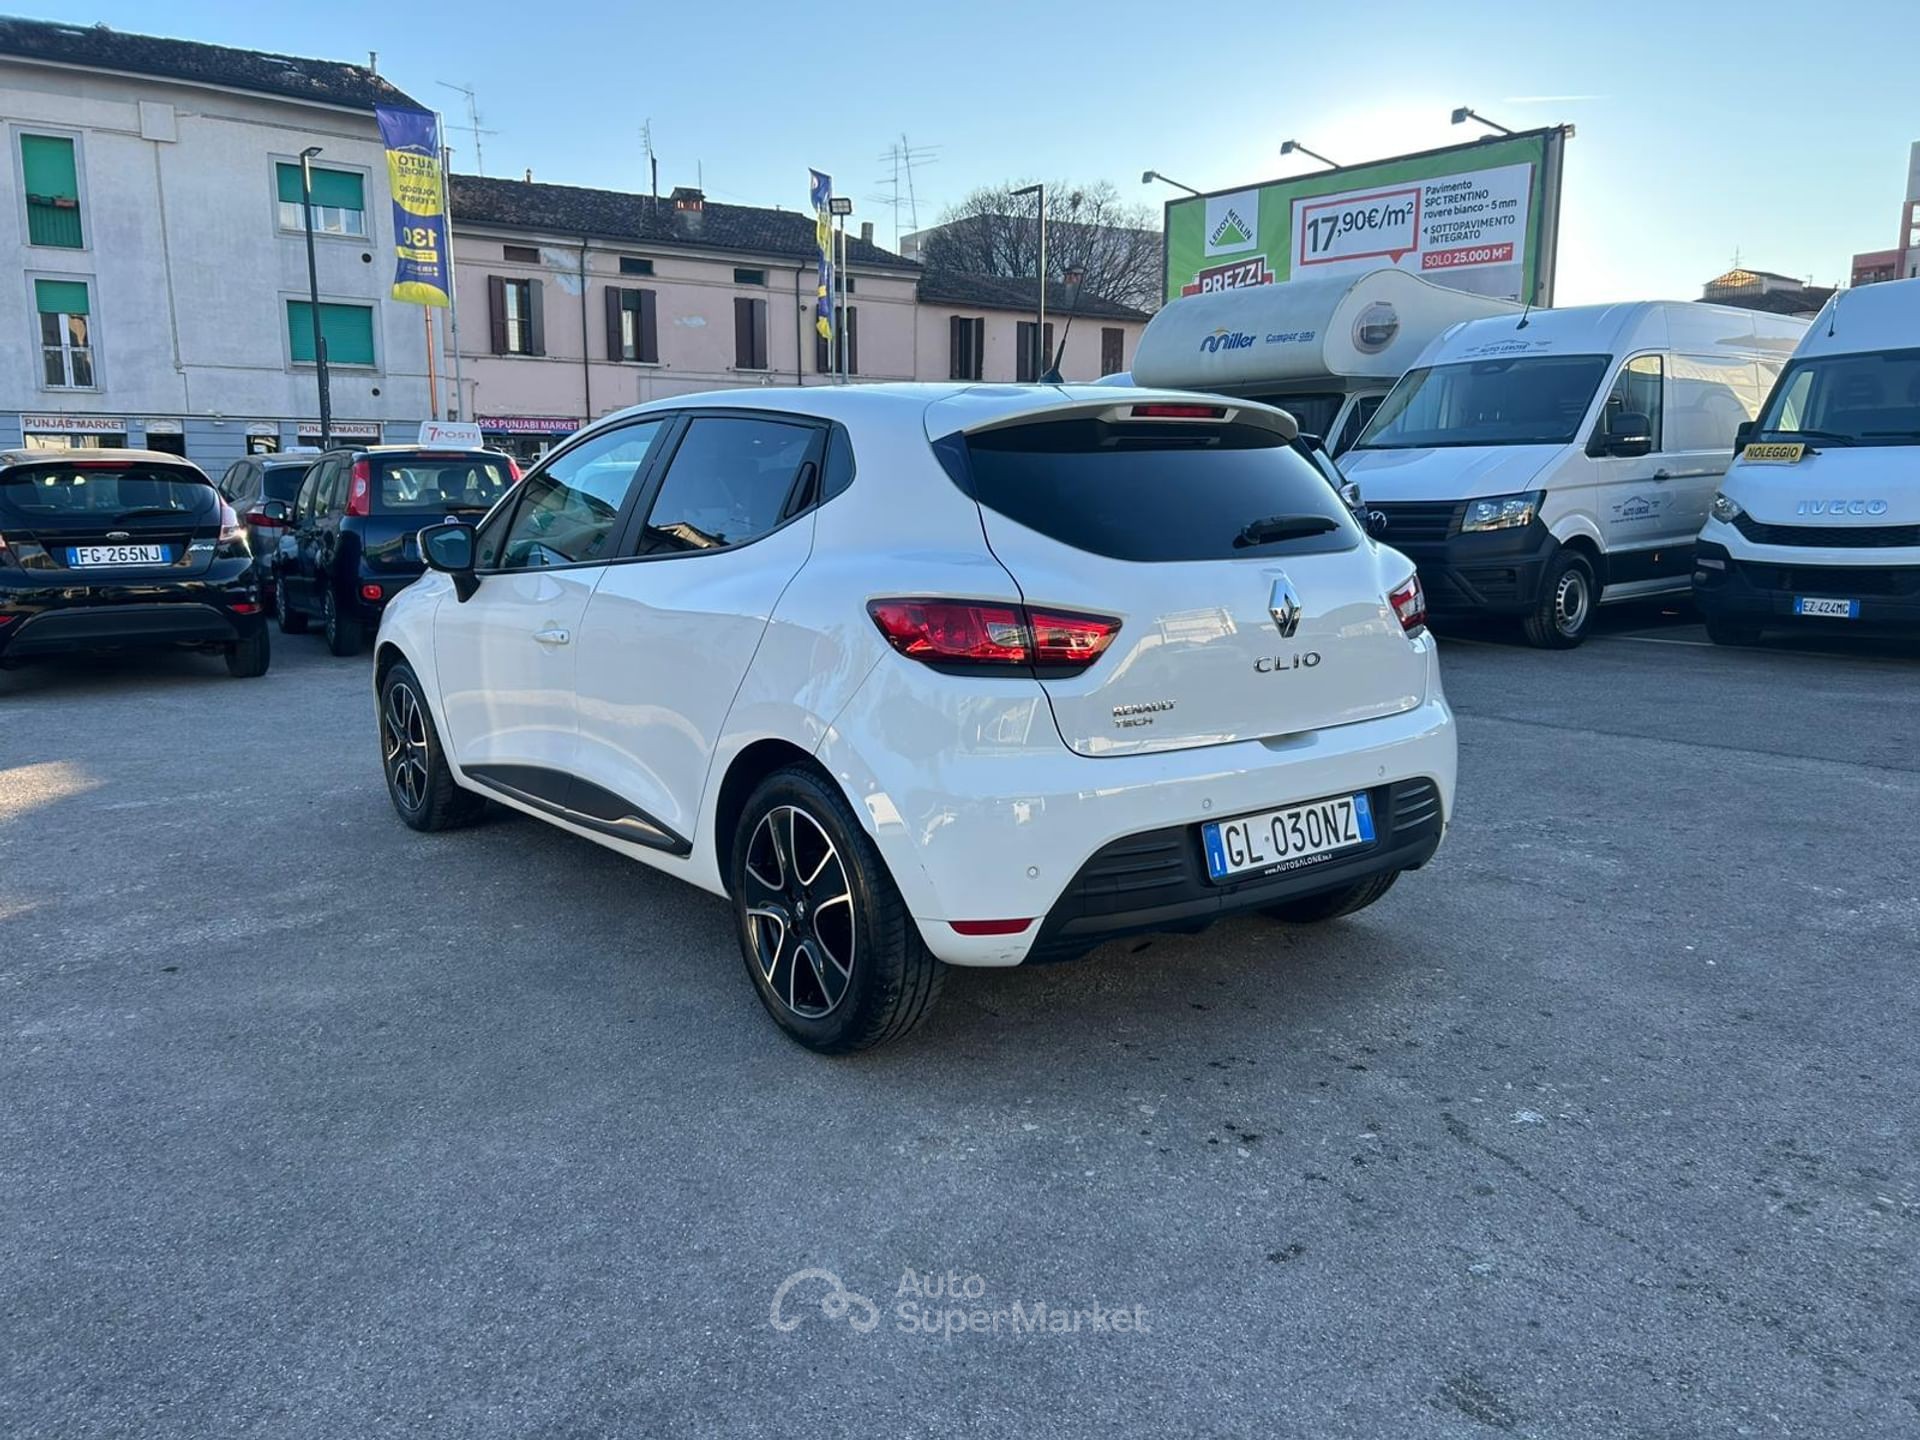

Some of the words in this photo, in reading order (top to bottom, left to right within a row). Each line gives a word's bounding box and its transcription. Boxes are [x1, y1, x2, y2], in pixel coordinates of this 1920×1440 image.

[1425, 180, 1472, 195] Pavimento
[1424, 196, 1441, 208] SPC
[1443, 189, 1489, 205] TRENTINO
[1424, 209, 1453, 219] rovere
[1454, 202, 1484, 215] bianco
[1490, 200, 1498, 210] 5
[1498, 199, 1517, 209] mm
[1209, 215, 1230, 246] LEROY
[1227, 207, 1254, 240] MERLIN
[1430, 214, 1516, 235] SOTTOPAVIMENTO
[1429, 229, 1481, 245] INTEGRATO
[1424, 253, 1452, 267] SOLO
[1452, 248, 1491, 264] 25.000
[1202, 261, 1263, 294] PREZZI
[1200, 332, 1256, 353] Miller
[76, 418, 126, 430] MARKET
[479, 418, 498, 430] SKS
[499, 418, 540, 430] PUNJABI
[541, 419, 580, 431] MARKET
[1746, 446, 1799, 459] NOLEGGIO
[1797, 499, 1889, 516] IVECO
[79, 549, 102, 564] FG
[108, 546, 161, 563] 265NJ
[1803, 600, 1816, 613] EZ
[1253, 651, 1321, 673] CLIO
[1112, 700, 1176, 717] RENAULT
[1114, 717, 1154, 729] TECH
[1225, 822, 1264, 868] GL
[1270, 801, 1357, 856] 030NZ
